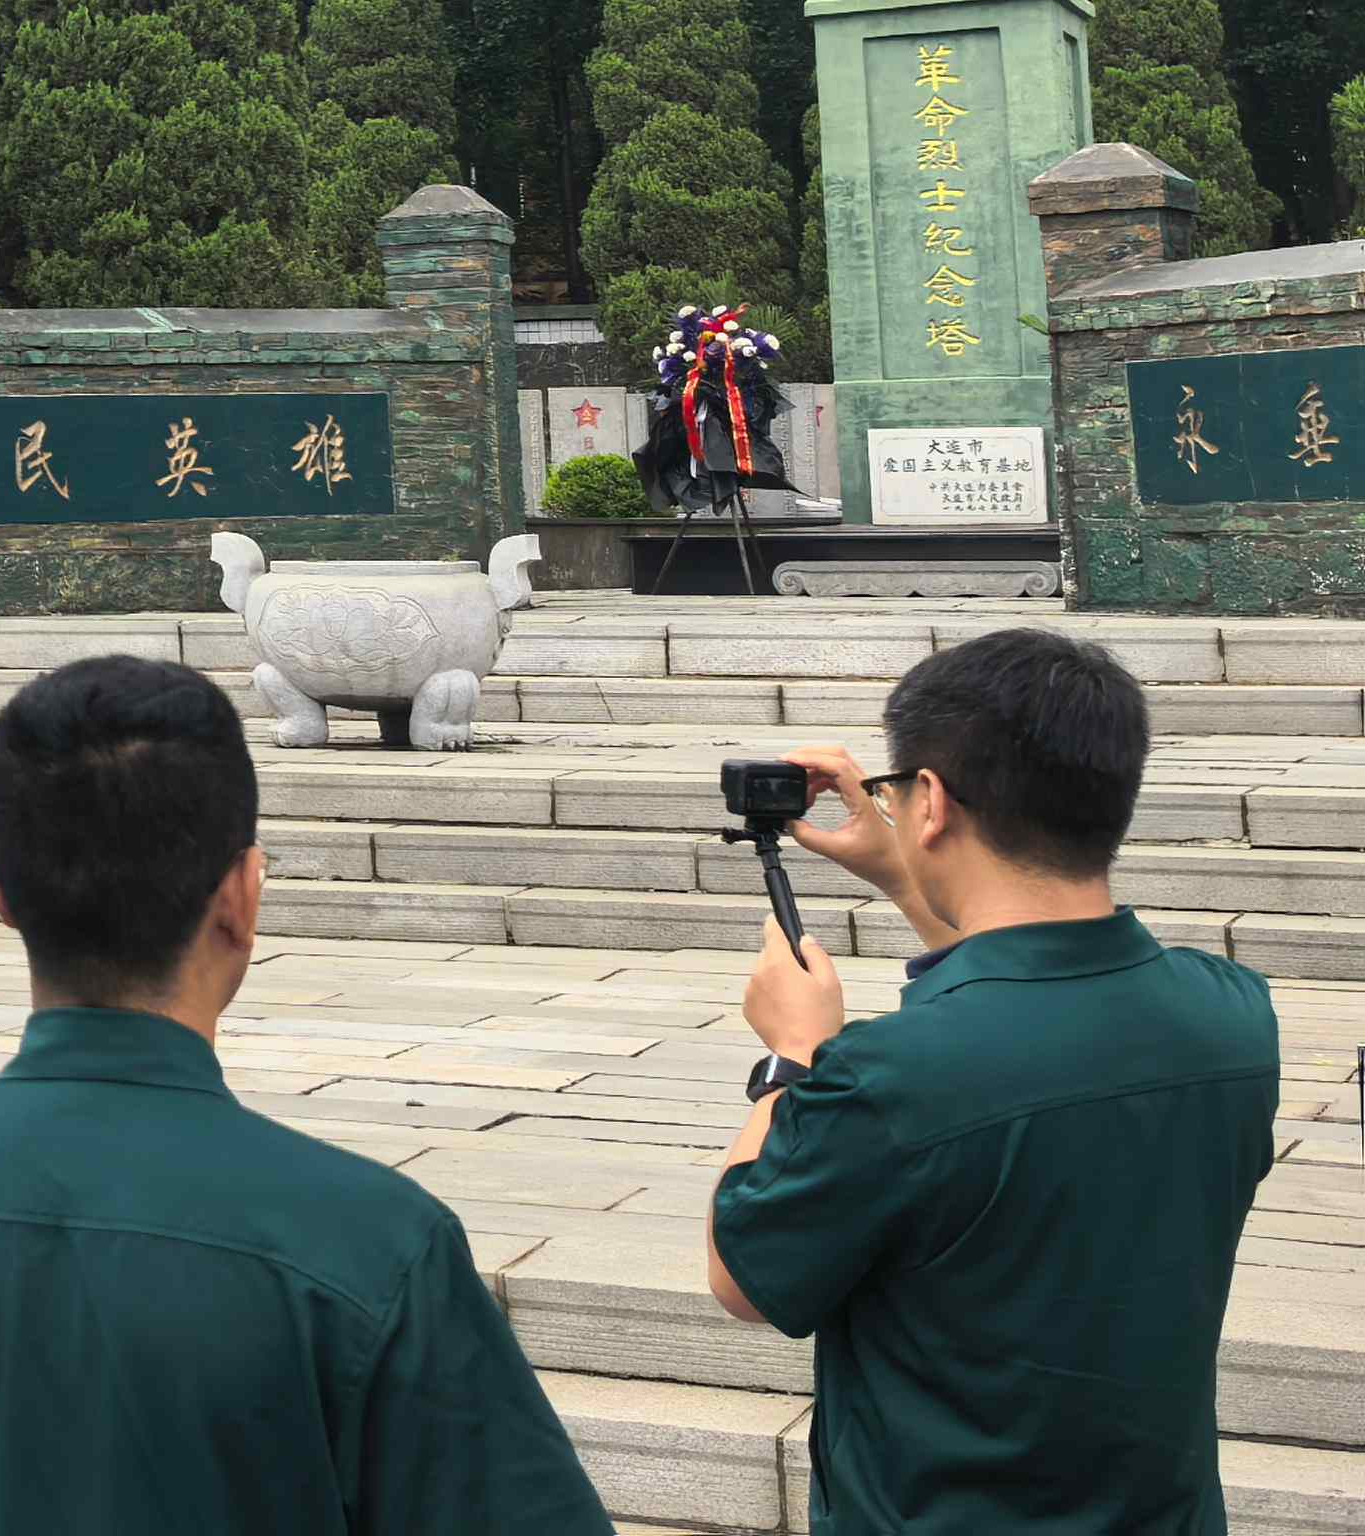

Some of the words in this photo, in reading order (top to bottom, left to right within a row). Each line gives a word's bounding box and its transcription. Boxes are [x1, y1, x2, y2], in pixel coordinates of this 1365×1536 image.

[927, 438, 984, 456] 大连市
[884, 457, 1033, 474] 爱国主义教育基地
